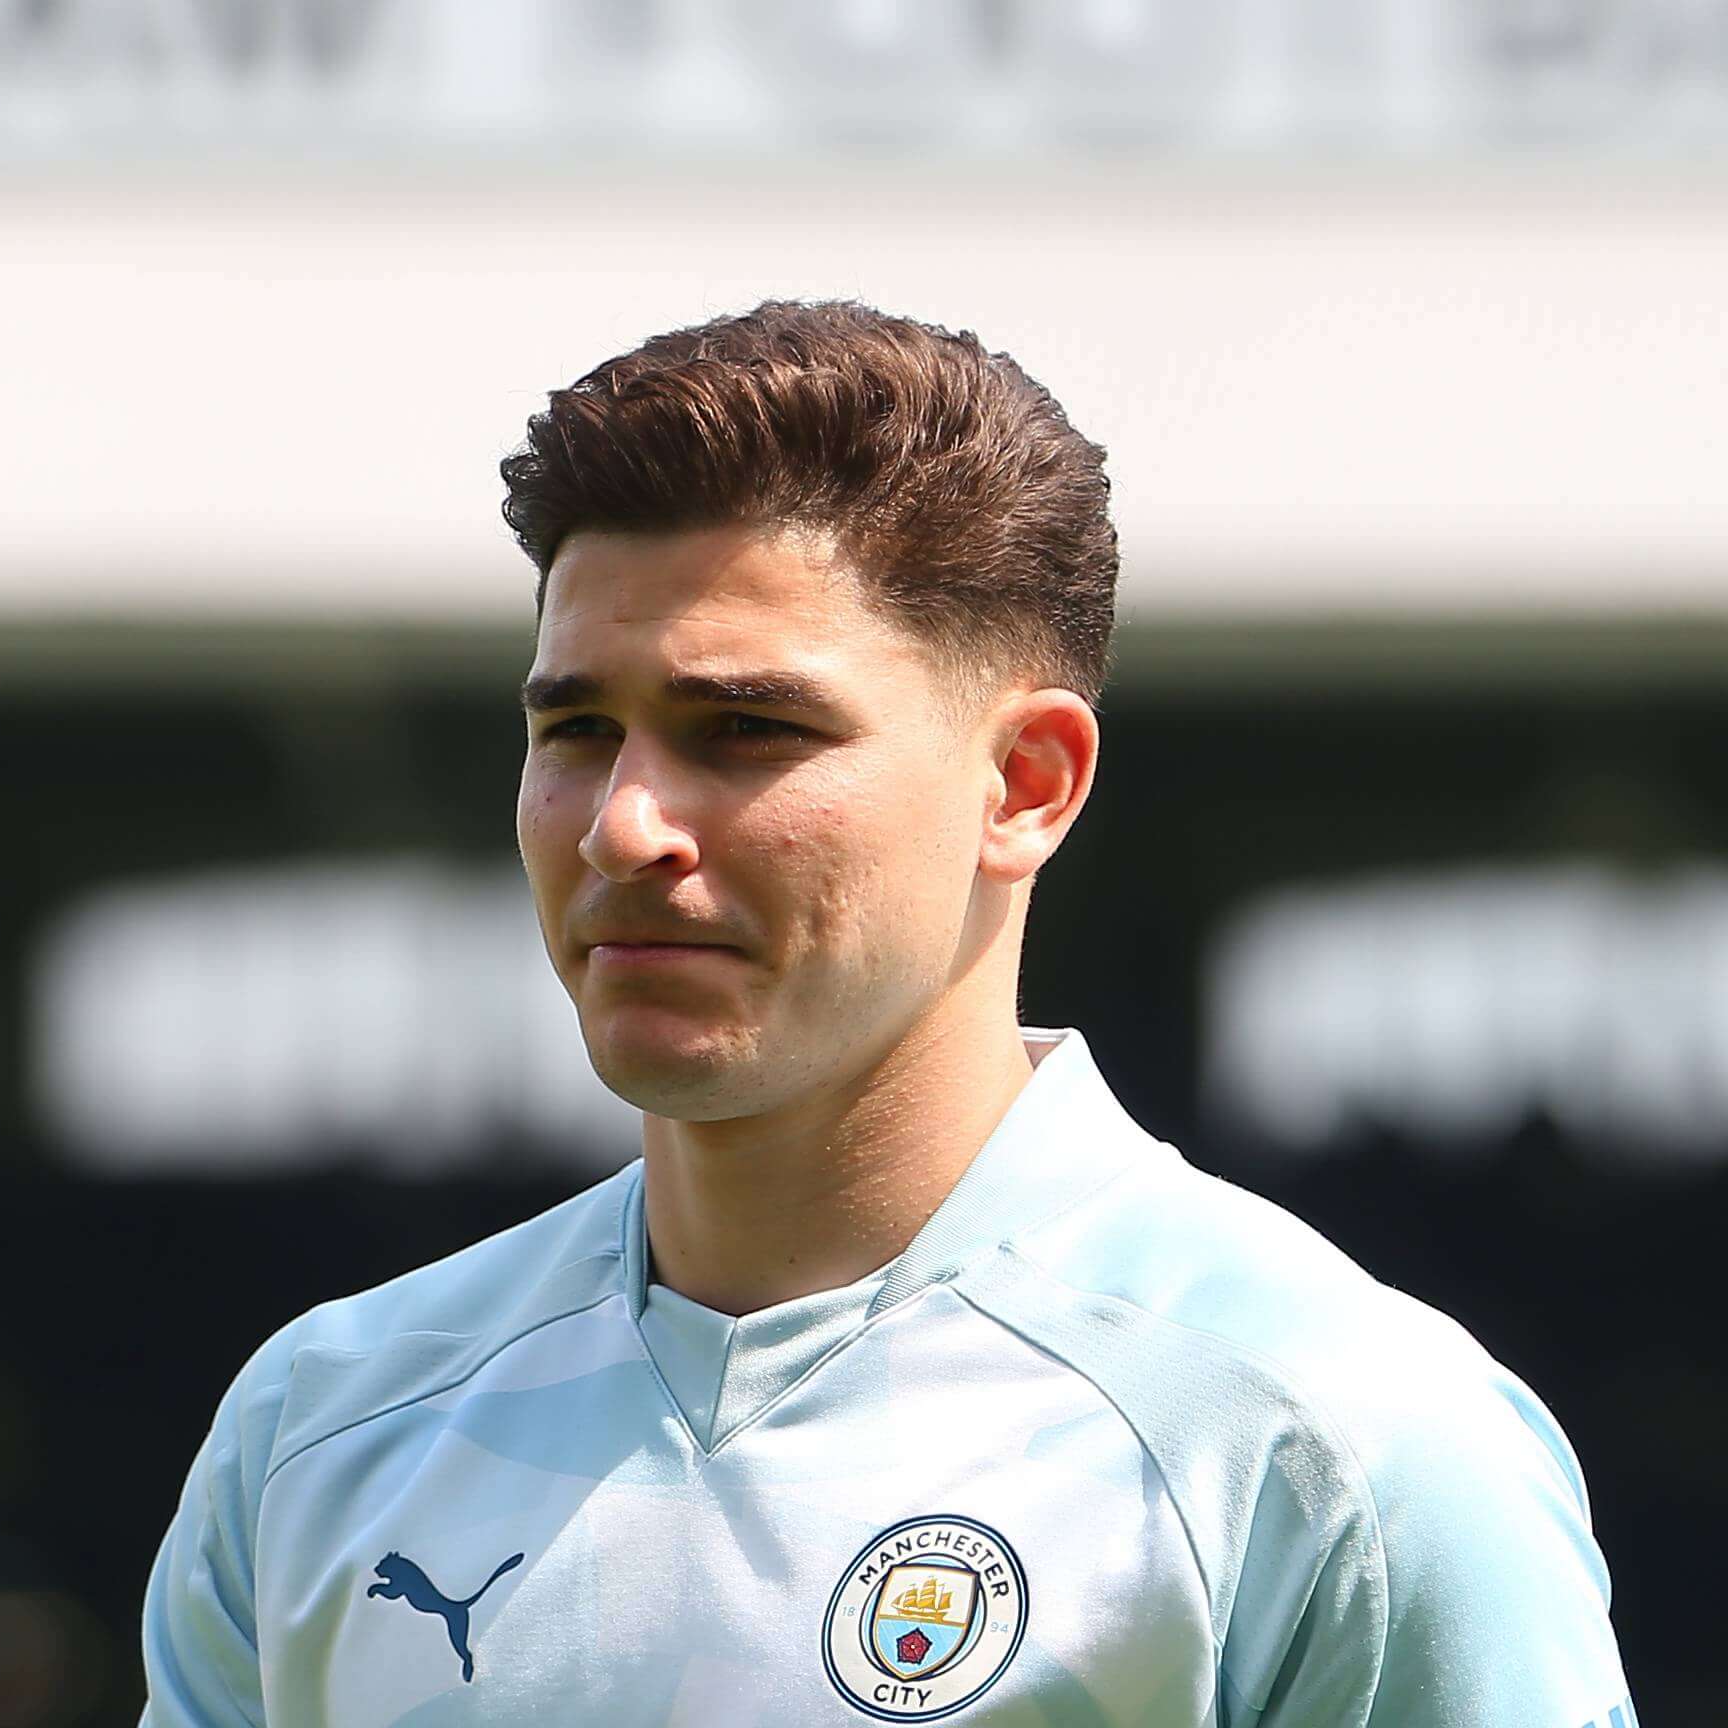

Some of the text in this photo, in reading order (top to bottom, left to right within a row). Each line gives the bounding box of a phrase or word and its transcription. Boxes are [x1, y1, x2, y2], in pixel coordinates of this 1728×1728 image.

[858, 1530, 1010, 1599] MANCHESTER
[842, 1606, 1009, 1634] 18 94
[873, 1683, 933, 1708] CITY
